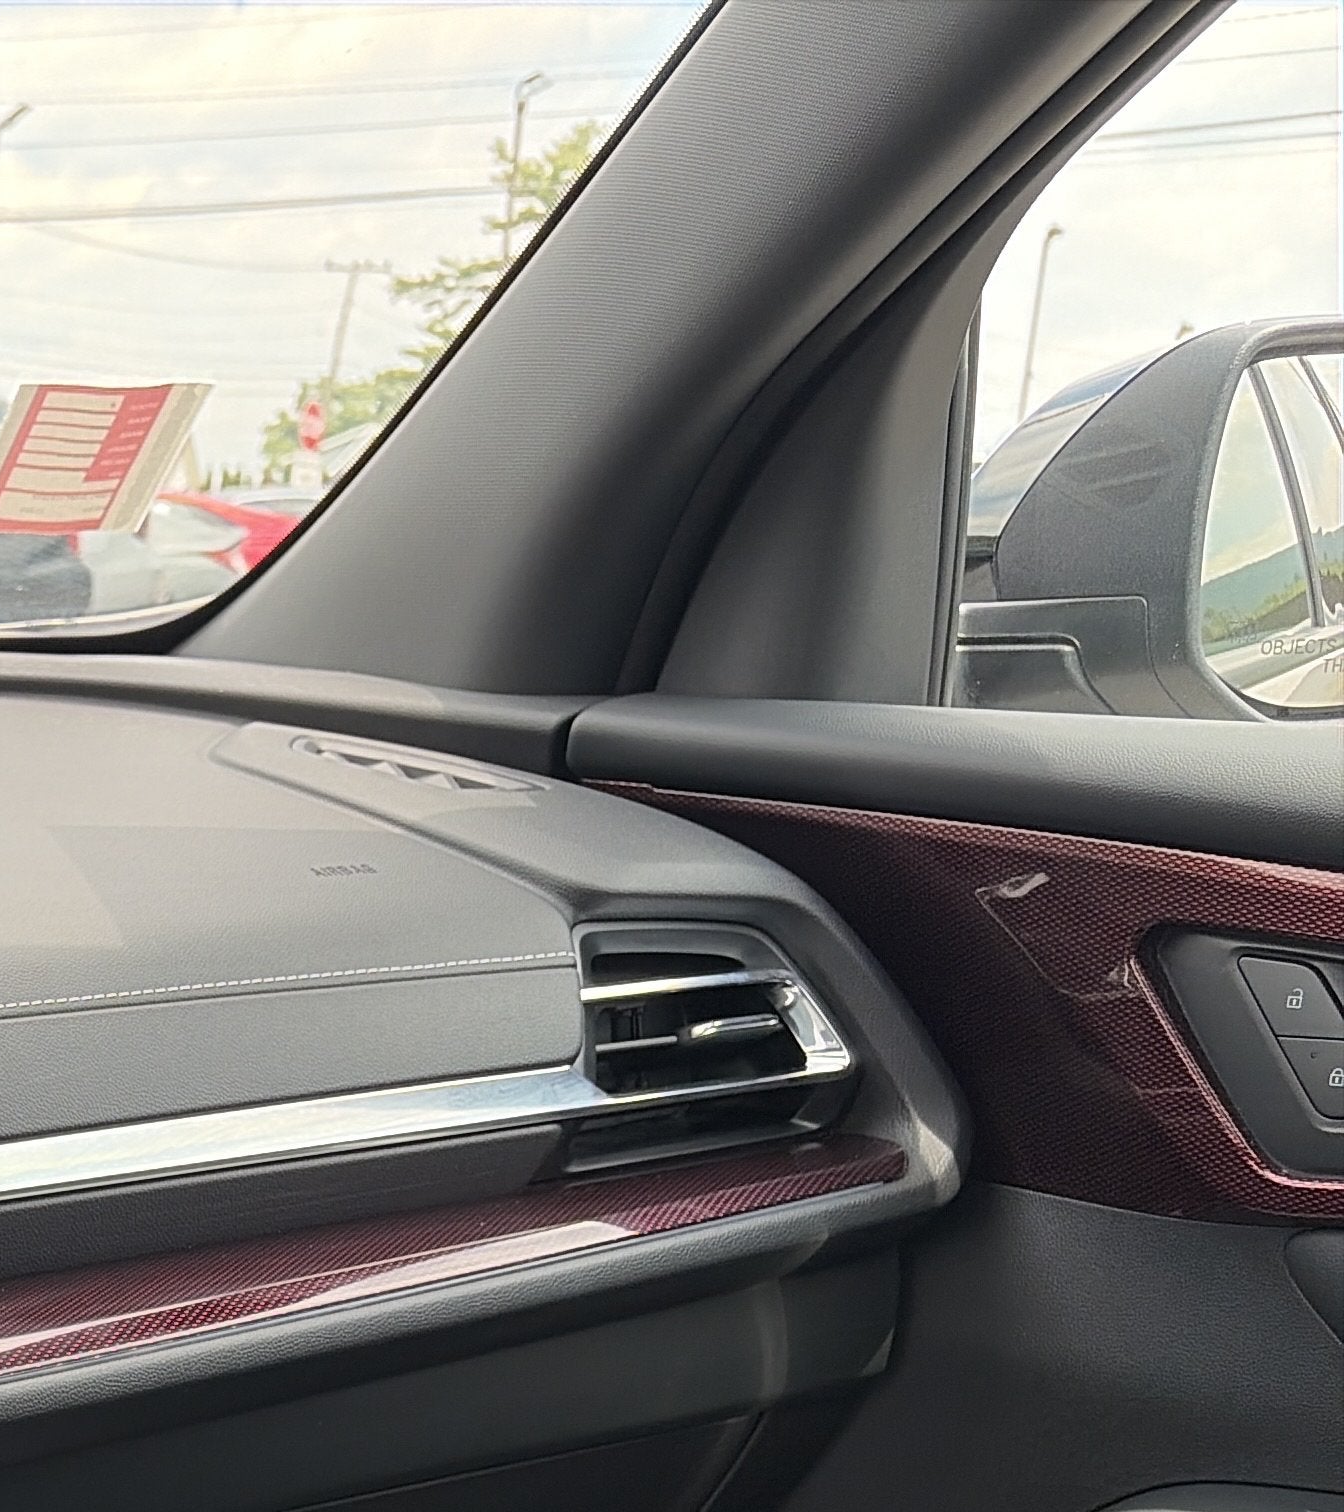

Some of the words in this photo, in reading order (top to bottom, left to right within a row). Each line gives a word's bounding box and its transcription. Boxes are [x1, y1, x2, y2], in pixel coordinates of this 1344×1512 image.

[1260, 638, 1337, 656] OBJECTS
[1323, 658, 1343, 673] TH
[310, 863, 378, 877] AIRBAG
